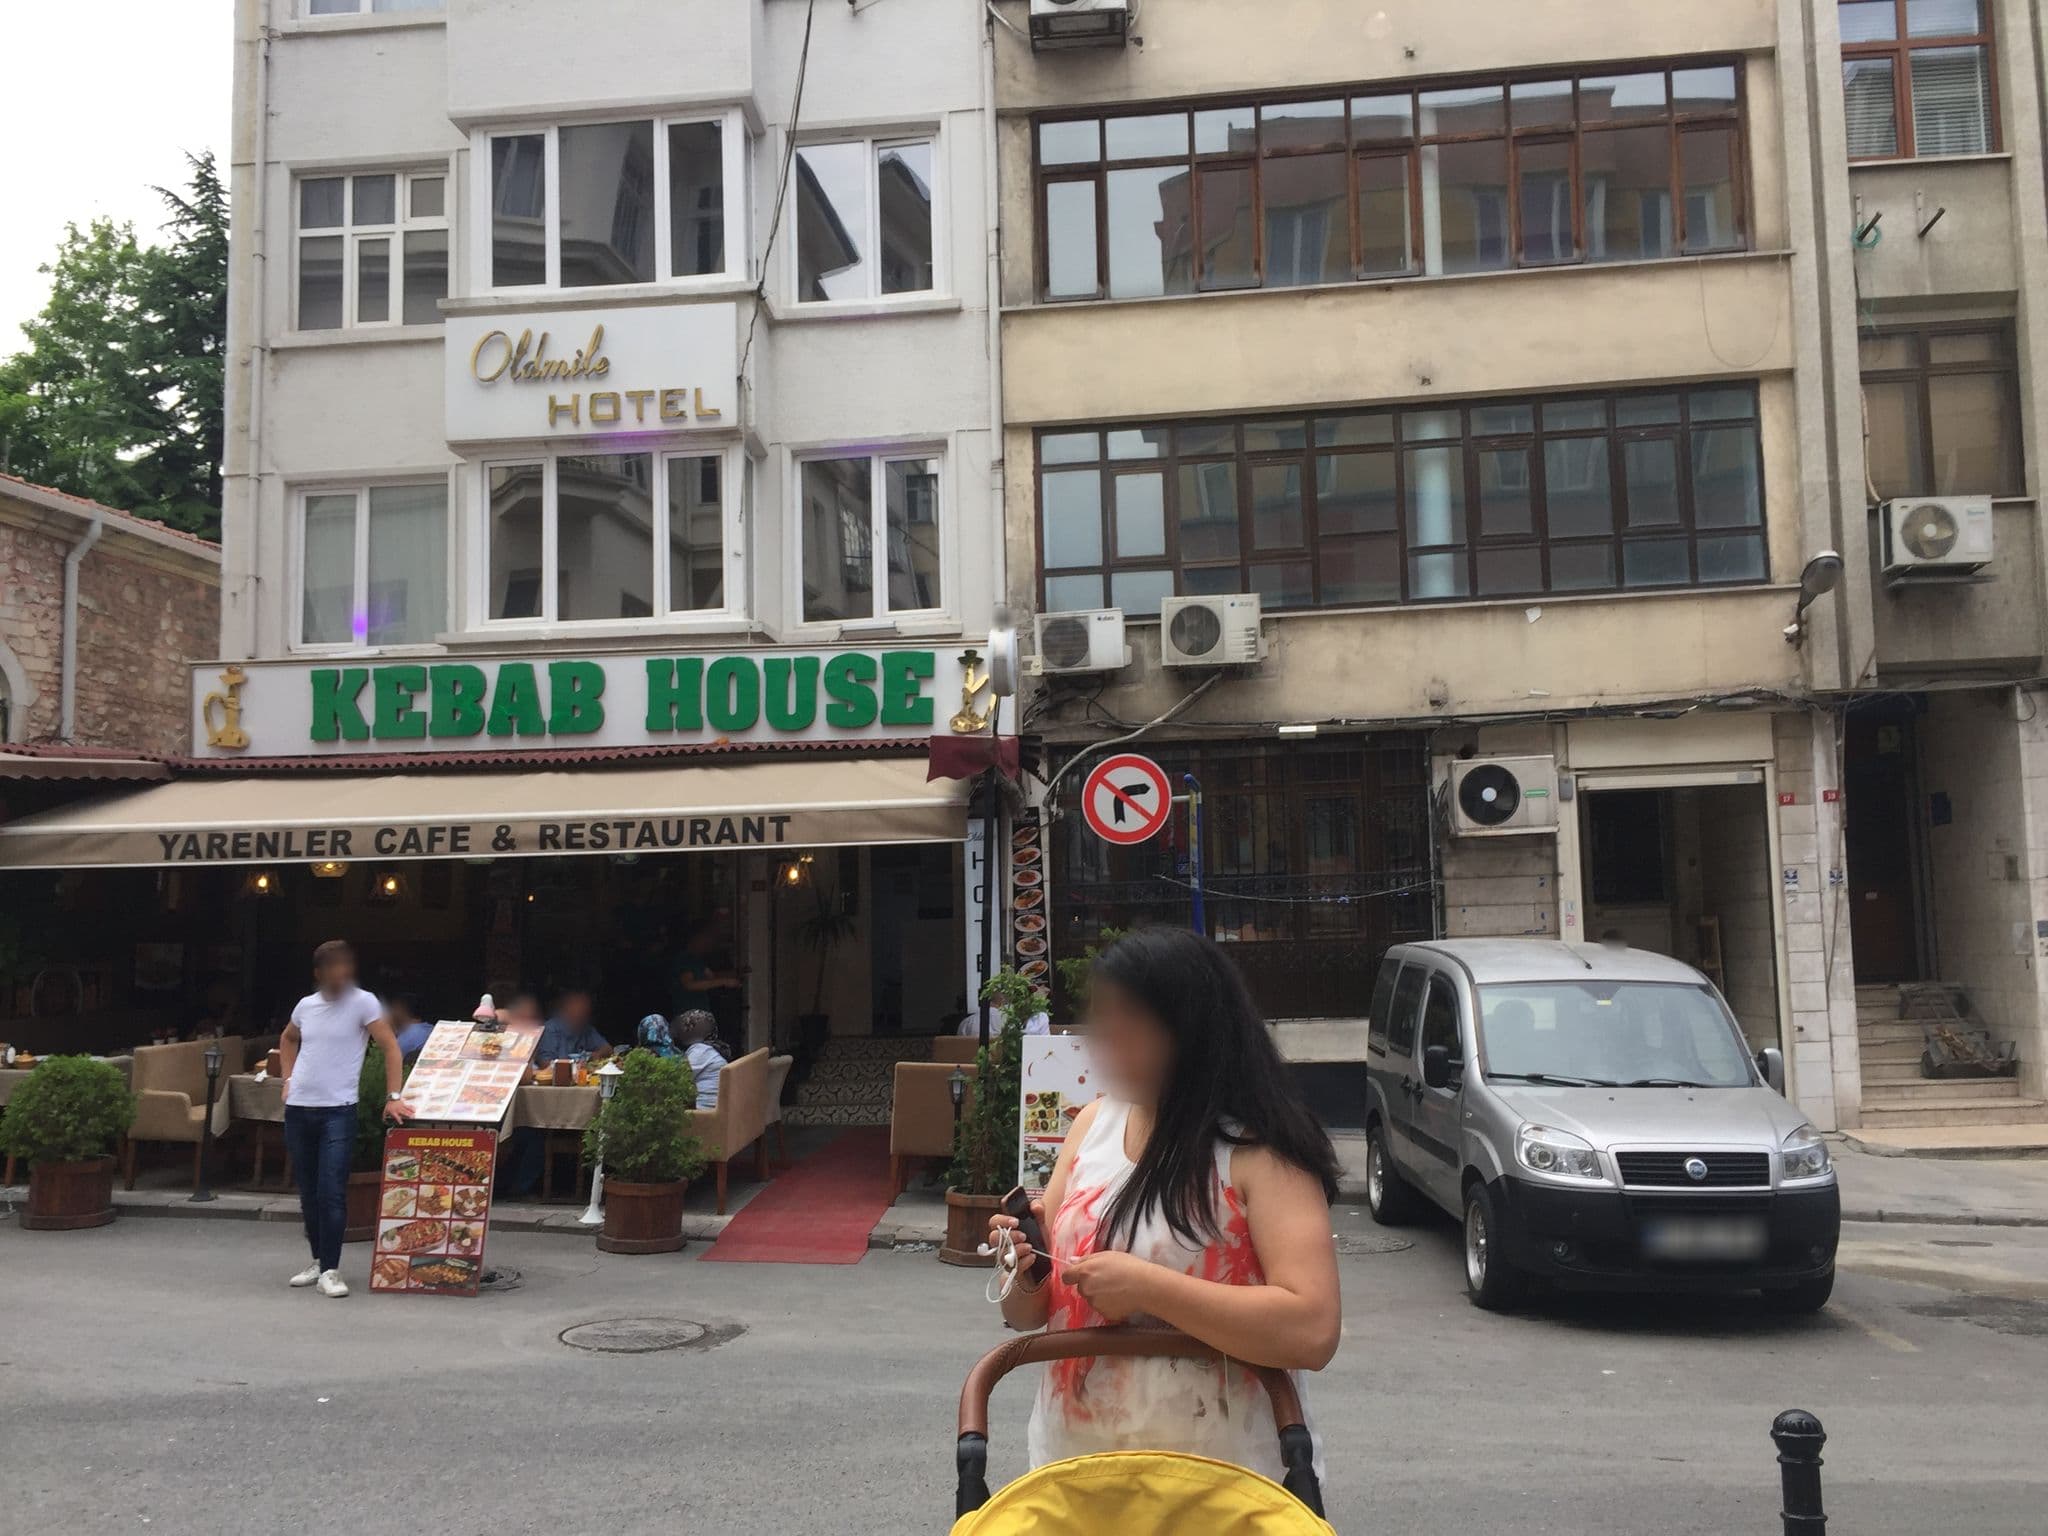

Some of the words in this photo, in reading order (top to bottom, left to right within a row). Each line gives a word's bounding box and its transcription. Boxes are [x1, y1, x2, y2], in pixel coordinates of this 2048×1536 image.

[470, 323, 610, 382] Oldmile
[548, 387, 722, 426] HOTEL
[310, 660, 606, 742] KEBAB
[645, 650, 936, 732] HOUSE
[158, 829, 353, 860] YARENLER
[374, 826, 471, 855] CAFE
[491, 824, 516, 852] &
[538, 815, 792, 850] RESTAURANT
[408, 1137, 441, 1147] KEBAB
[441, 1138, 474, 1147] HOUSE
